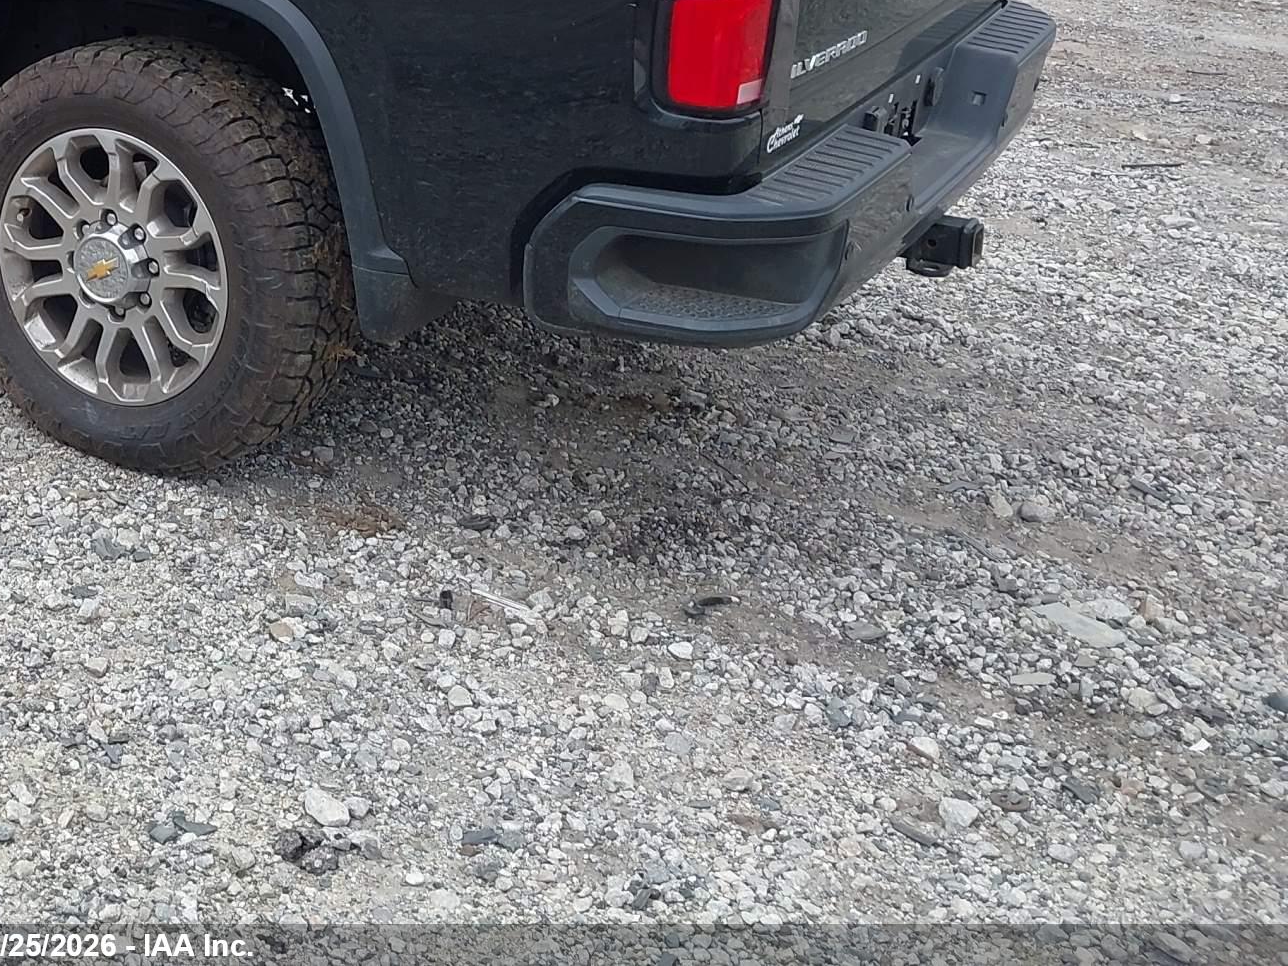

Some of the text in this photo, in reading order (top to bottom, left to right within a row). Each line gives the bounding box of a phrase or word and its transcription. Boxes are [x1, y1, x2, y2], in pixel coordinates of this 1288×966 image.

[790, 30, 868, 79] ILVERADO
[767, 124, 800, 154] Chevrolet
[775, 121, 793, 137] Athens
